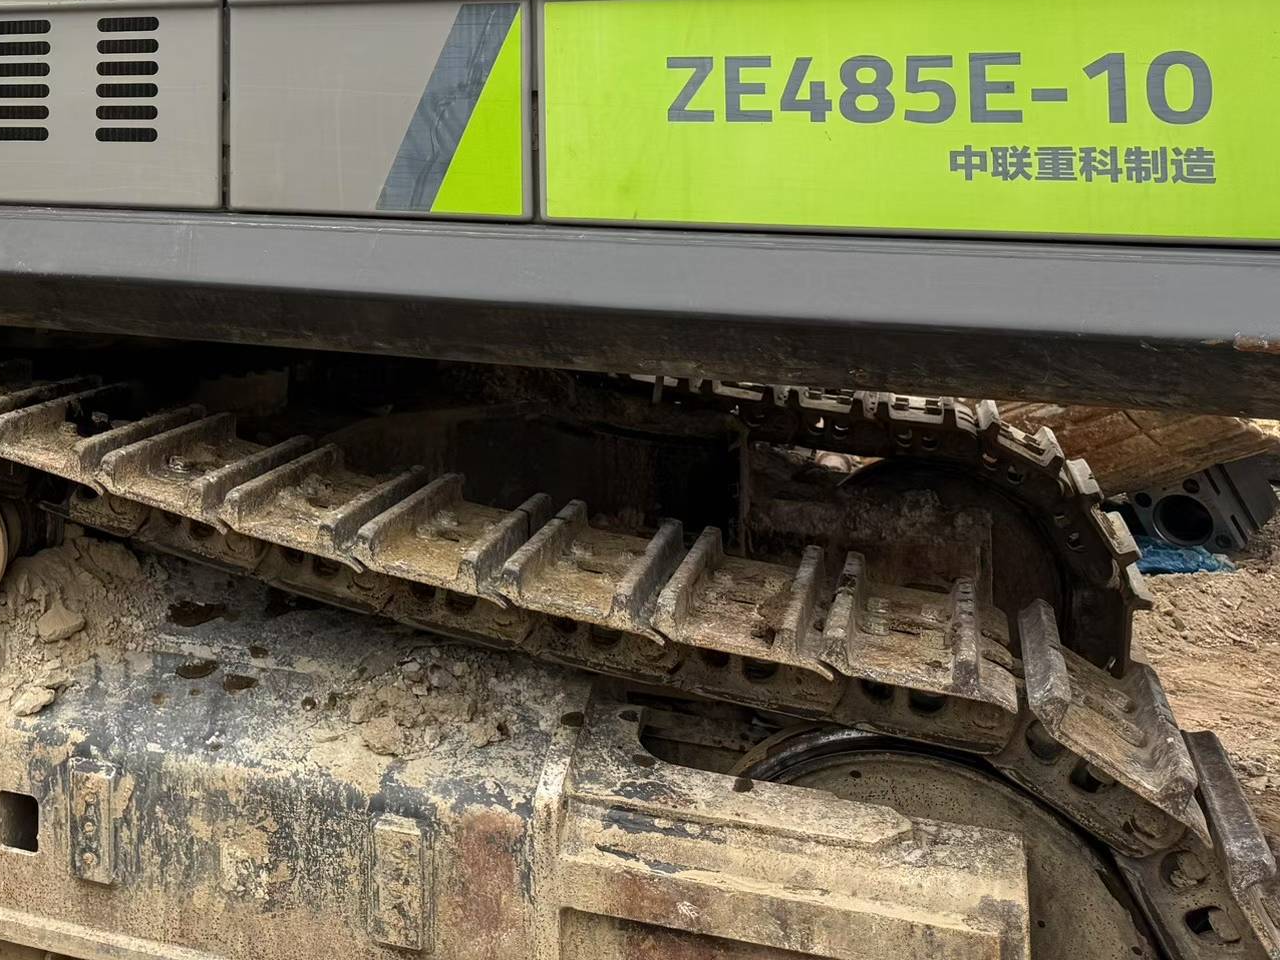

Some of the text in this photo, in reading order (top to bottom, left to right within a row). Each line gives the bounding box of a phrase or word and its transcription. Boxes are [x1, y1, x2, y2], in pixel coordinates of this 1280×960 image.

[666, 51, 1213, 125] ZE485E-10
[949, 145, 1216, 184] 中联重科制造
